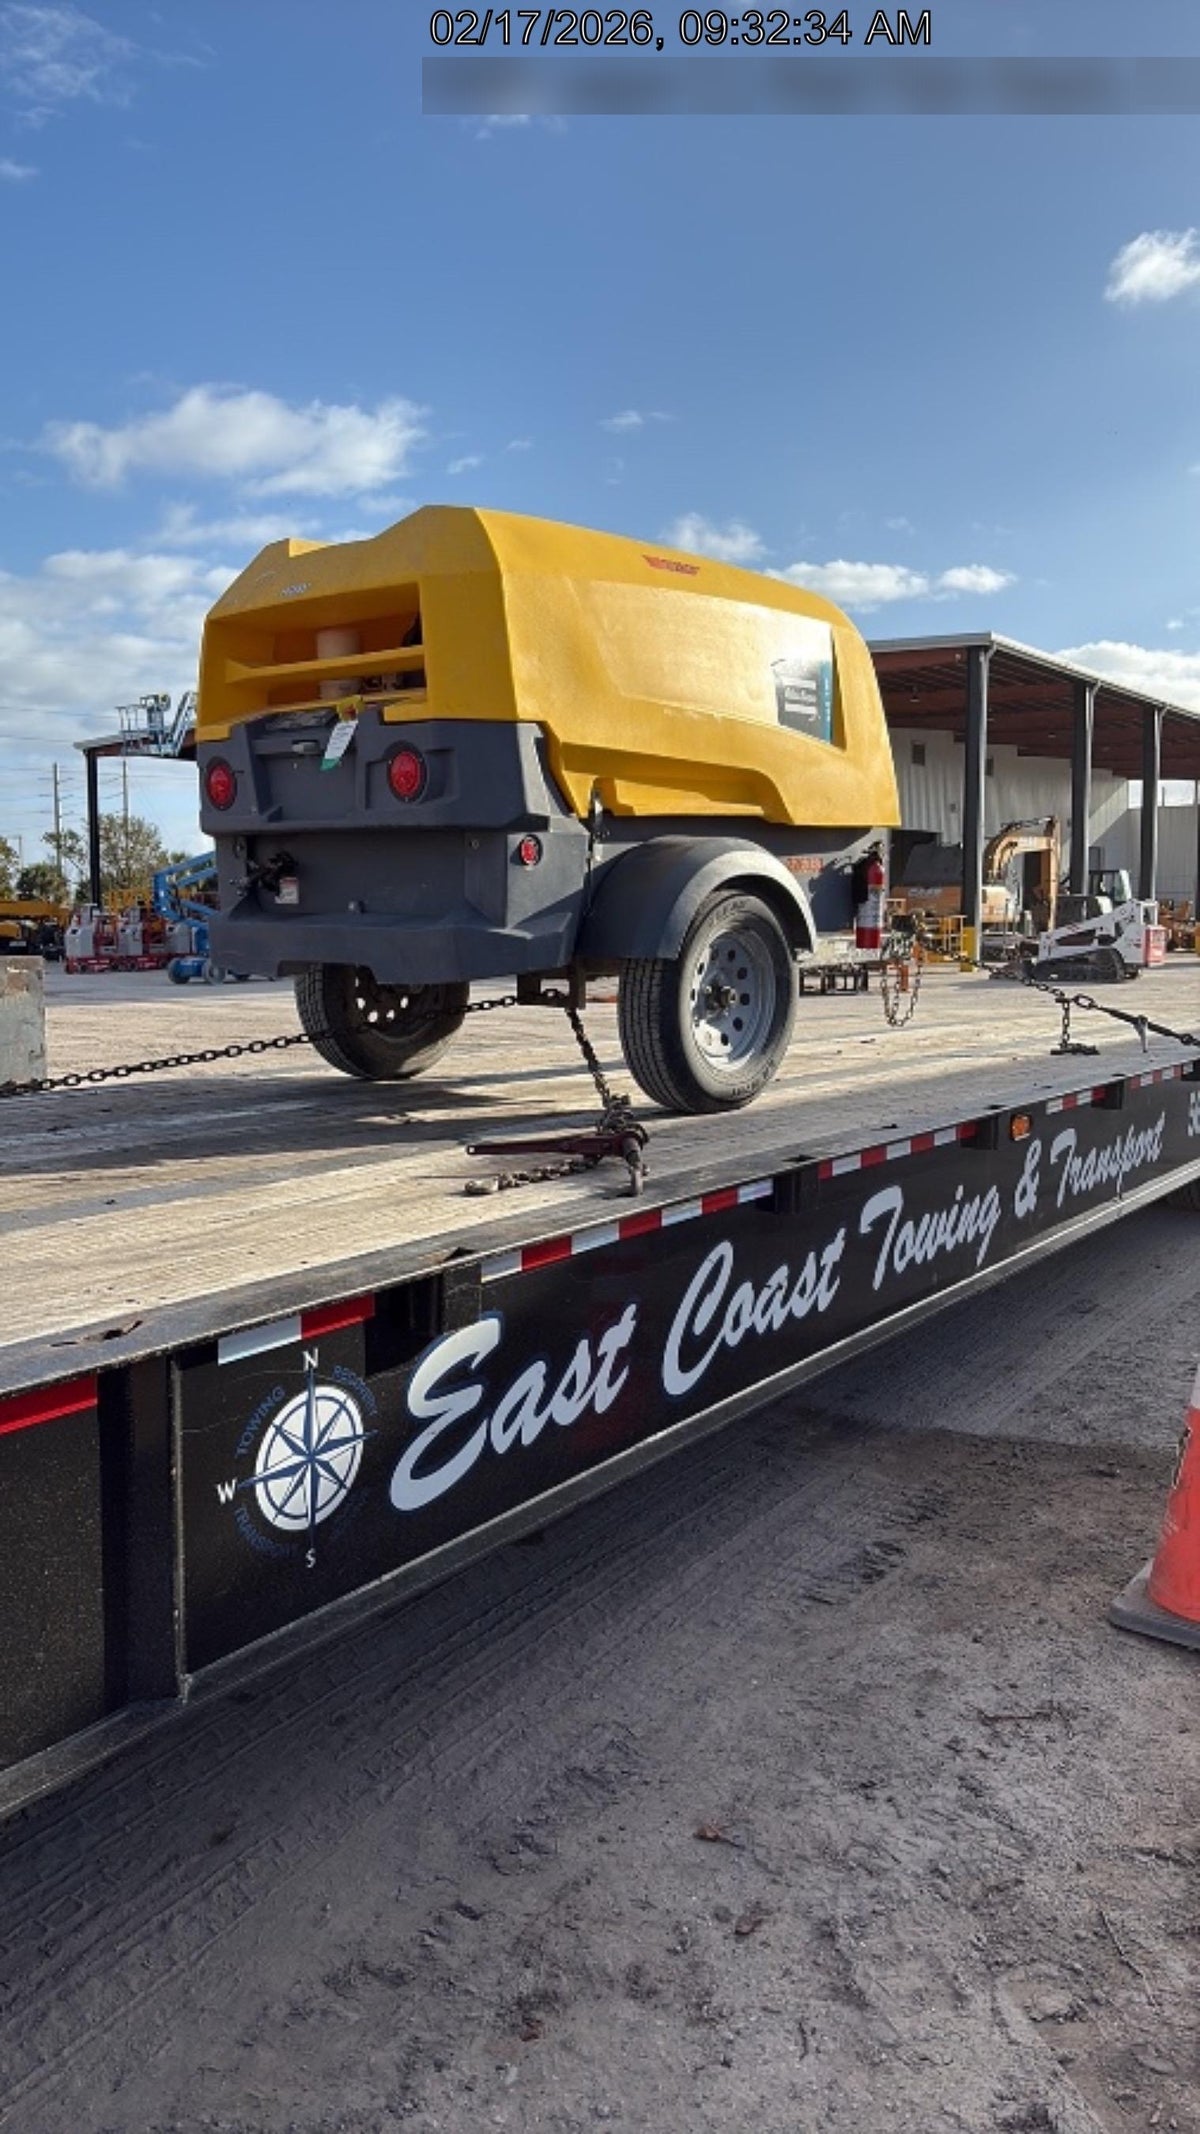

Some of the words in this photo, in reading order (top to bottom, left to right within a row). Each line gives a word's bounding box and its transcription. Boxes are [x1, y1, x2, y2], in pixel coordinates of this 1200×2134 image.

[390, 1303, 637, 1511] East
[662, 1226, 846, 1396] Coast
[860, 1185, 1000, 1290] Towing
[1014, 1139, 1042, 1218] &
[1051, 1111, 1165, 1207] Transport
[303, 1347, 319, 1370] N
[235, 1386, 286, 1458] TOWING
[217, 1478, 237, 1503] W
[305, 1548, 316, 1568] S
